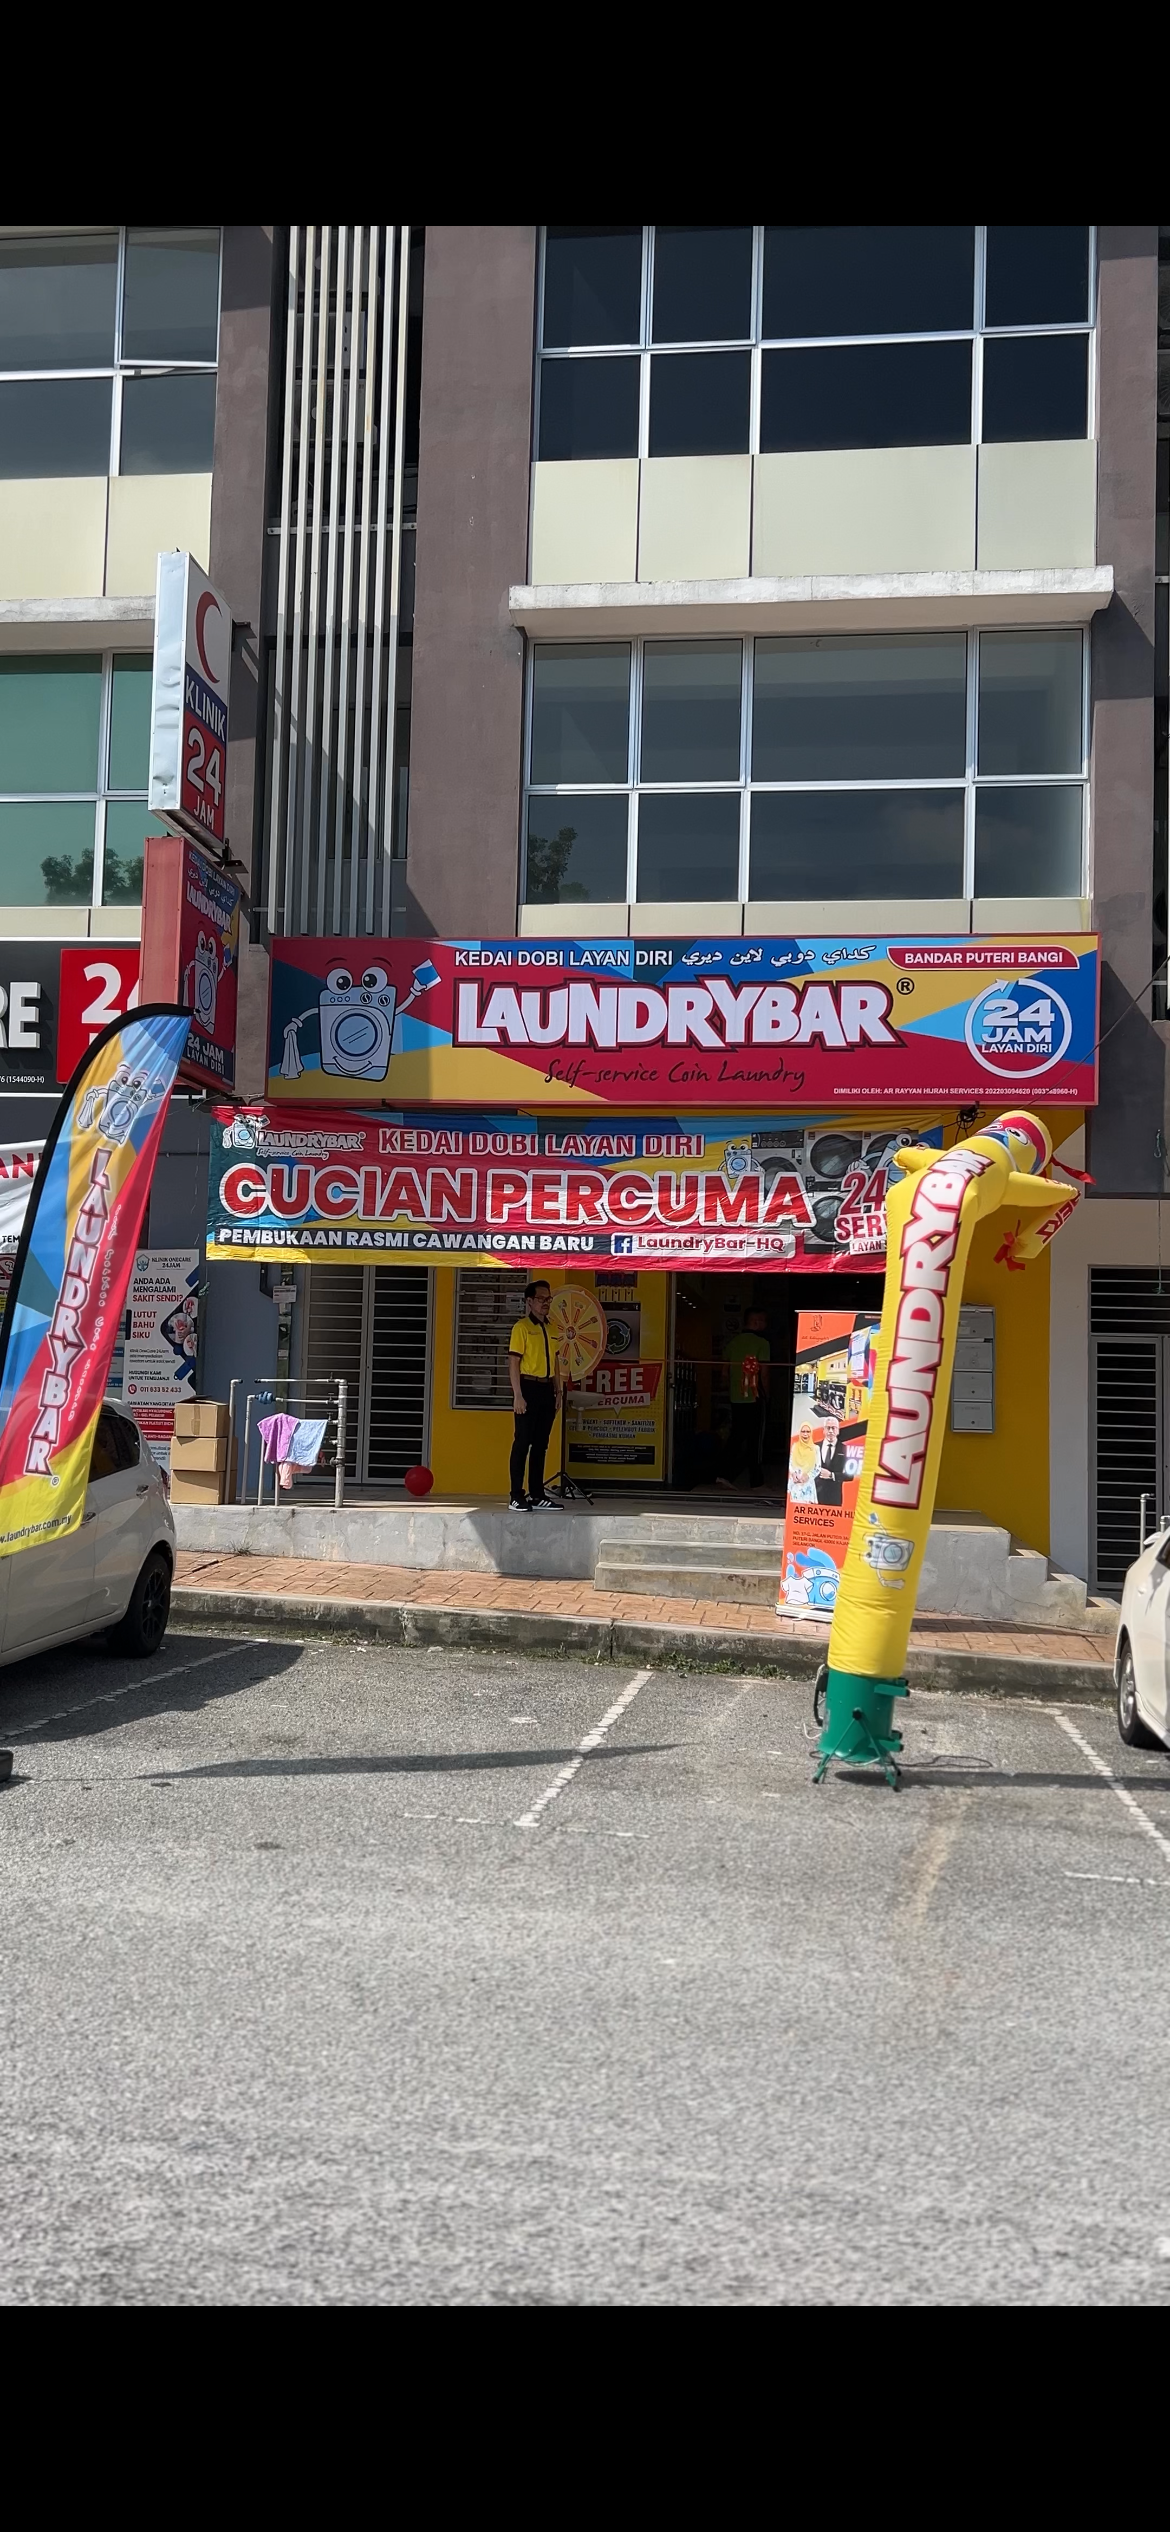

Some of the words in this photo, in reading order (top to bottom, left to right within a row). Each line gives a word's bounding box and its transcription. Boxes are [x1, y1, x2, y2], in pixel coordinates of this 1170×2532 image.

[186, 675, 226, 742] KLINIK
[187, 727, 222, 807] 24
[194, 795, 215, 830] JAM
[187, 881, 232, 934] LAUNDRYBAR
[455, 950, 513, 967] KEDAI
[518, 950, 564, 967] DOBI
[569, 950, 630, 966] LAYAN
[635, 949, 673, 966] DIRI
[904, 952, 963, 965] BANDAR
[965, 951, 1014, 964] PUTERI
[1017, 950, 1064, 963] BANGI
[0, 981, 42, 1049] E
[454, 976, 902, 1051] LAUNDRYBAR
[982, 998, 1055, 1026] 24
[981, 1027, 1052, 1044] JAM
[187, 1032, 200, 1051] 24
[202, 1042, 224, 1064] JAM
[982, 1043, 1024, 1055] LAYAN
[1026, 1043, 1053, 1054] DIRI
[187, 1046, 209, 1067] LAYAN
[210, 1059, 225, 1075] DIRI
[6, 1075, 45, 1084] (1544090-H)
[544, 1058, 660, 1088] Self-service
[668, 1061, 711, 1084] Coin
[717, 1057, 806, 1093] Laundry
[833, 1087, 860, 1095] DIMILIKI
[861, 1087, 882, 1095] OLEH:
[883, 1087, 894, 1095] AR
[894, 1087, 922, 1095] RAYYAN
[949, 1087, 984, 1095] SERVICES
[257, 1130, 363, 1150] LAUNDRYBAR
[379, 1128, 462, 1155] KEDAI
[469, 1131, 538, 1155] DOBI
[545, 1133, 635, 1157] LAYAN
[642, 1133, 705, 1158] DIRI
[219, 1162, 477, 1223] CUCIAN
[486, 1168, 817, 1228] PERCUMA
[839, 1168, 887, 1215] 24
[218, 1227, 348, 1247] PEMBUKAAN
[350, 1231, 409, 1248] RASMI
[412, 1232, 535, 1250] CAWANGAN
[539, 1235, 594, 1252] BARU
[637, 1236, 786, 1253] LaundryBar-HQ
[853, 1240, 882, 1252] LAYAN
[133, 1277, 154, 1285] ANDA
[155, 1277, 171, 1285] ADA
[132, 1294, 155, 1302] SAKIT
[156, 1294, 184, 1302] SENDI?
[24, 1148, 111, 1477] LAUNDRYBAR
[132, 1321, 155, 1329] BAHU
[132, 1331, 150, 1339] SIKU
[871, 1148, 996, 1510] LAUNDRYBAR
[597, 1395, 645, 1406] ERCUMA
[793, 1516, 835, 1528] SERVICES
[794, 1505, 806, 1514] AR
[807, 1506, 842, 1518] RAYYAN
